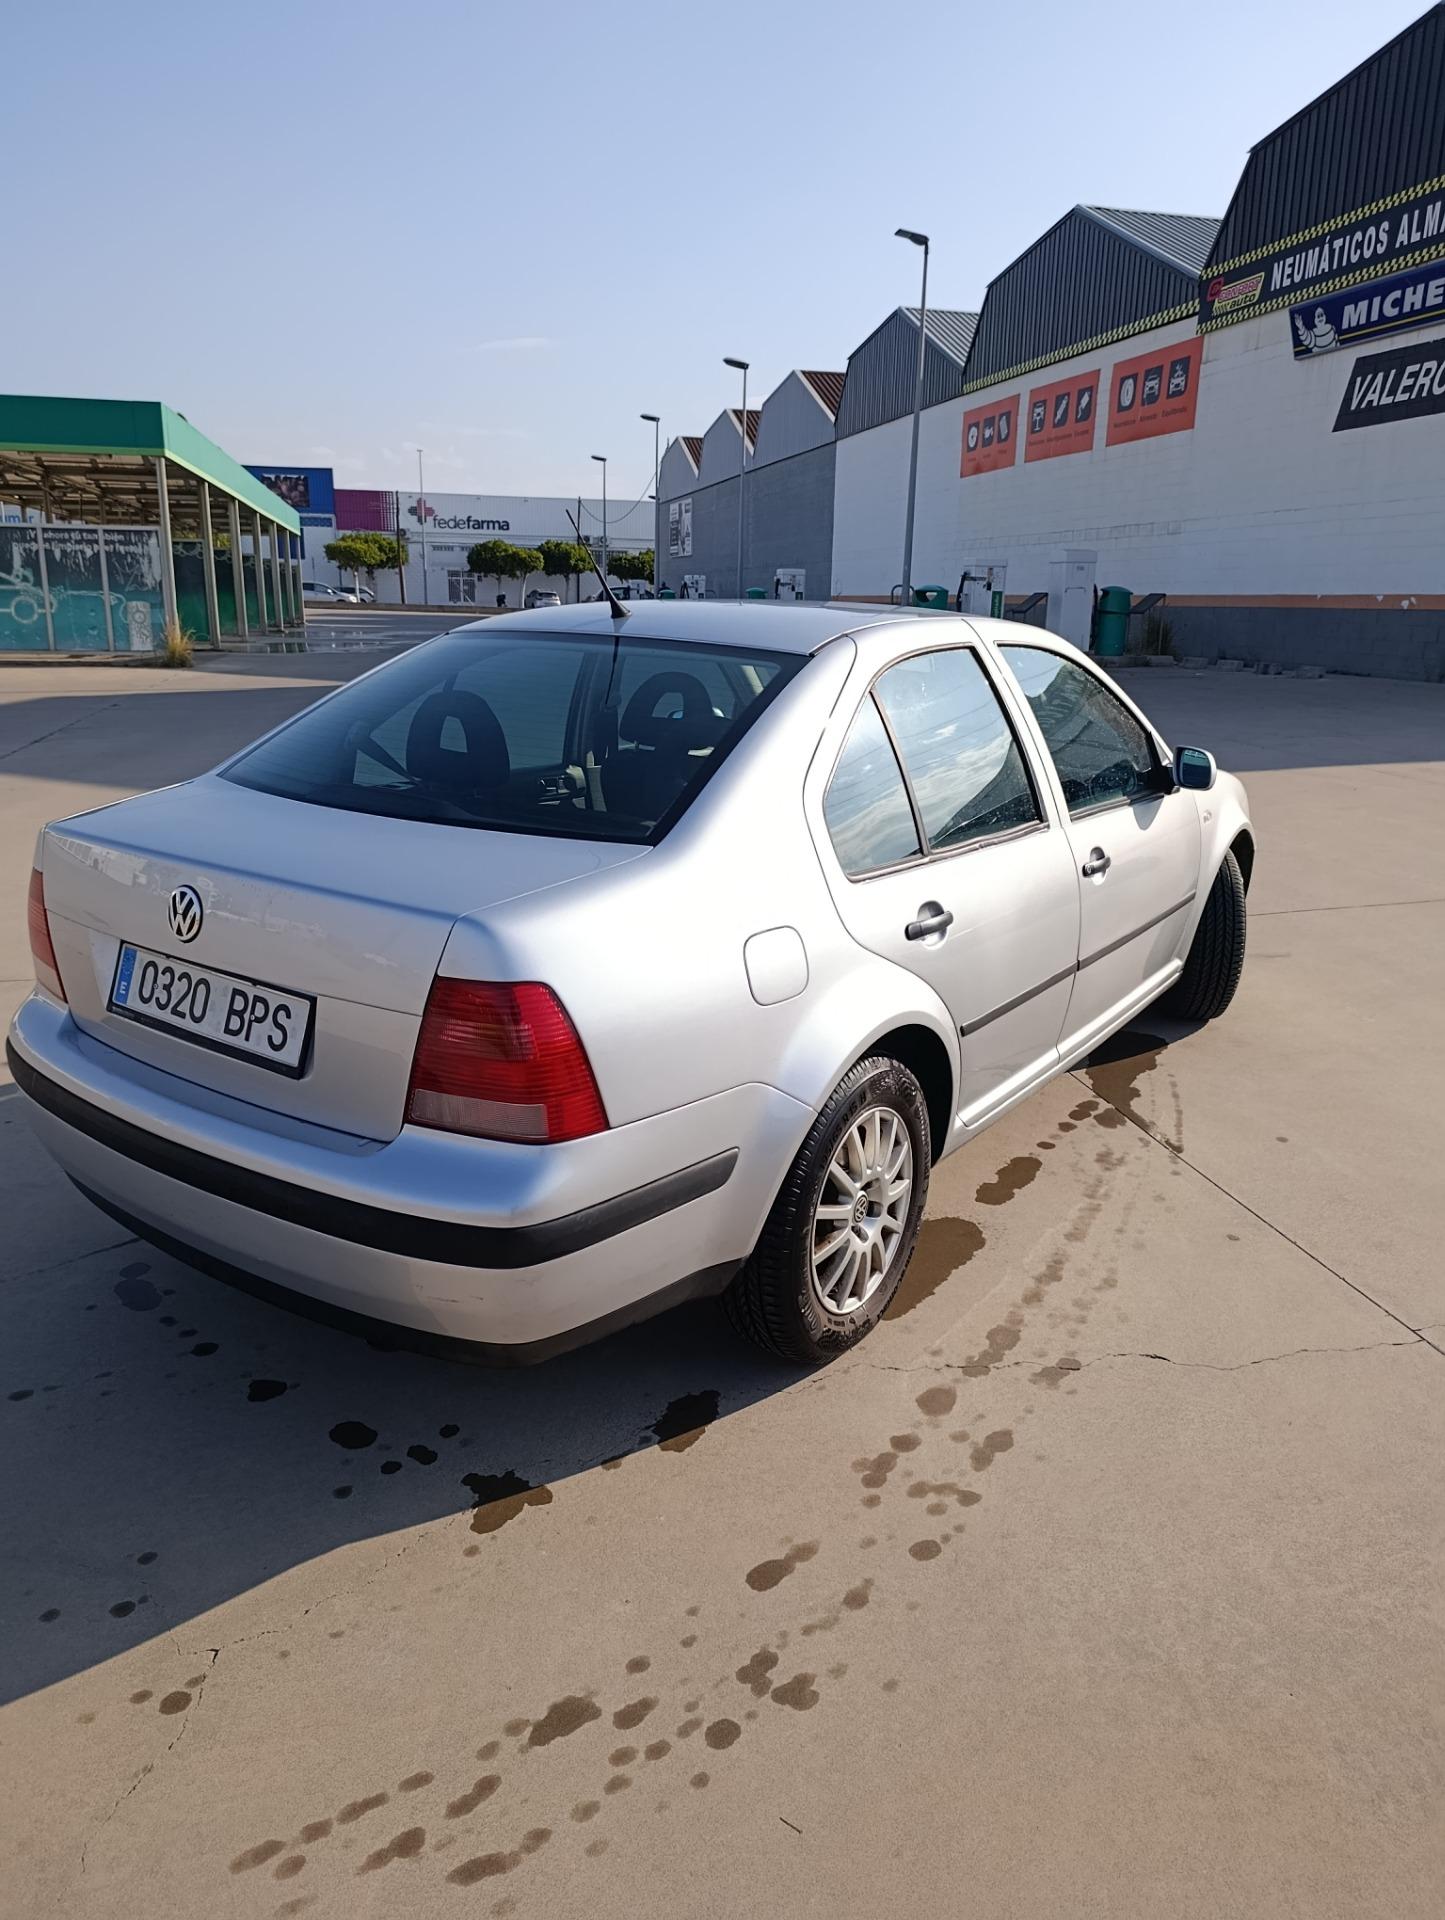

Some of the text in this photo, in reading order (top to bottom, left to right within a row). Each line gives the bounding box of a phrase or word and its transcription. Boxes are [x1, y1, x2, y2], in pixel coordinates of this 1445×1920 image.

[1270, 220, 1390, 292] NEUMÁTICOS
[1229, 293, 1257, 309] auto
[1341, 277, 1445, 330] MICHE
[433, 515, 510, 531] fedefarma
[138, 960, 292, 1052] 0320 BPS
